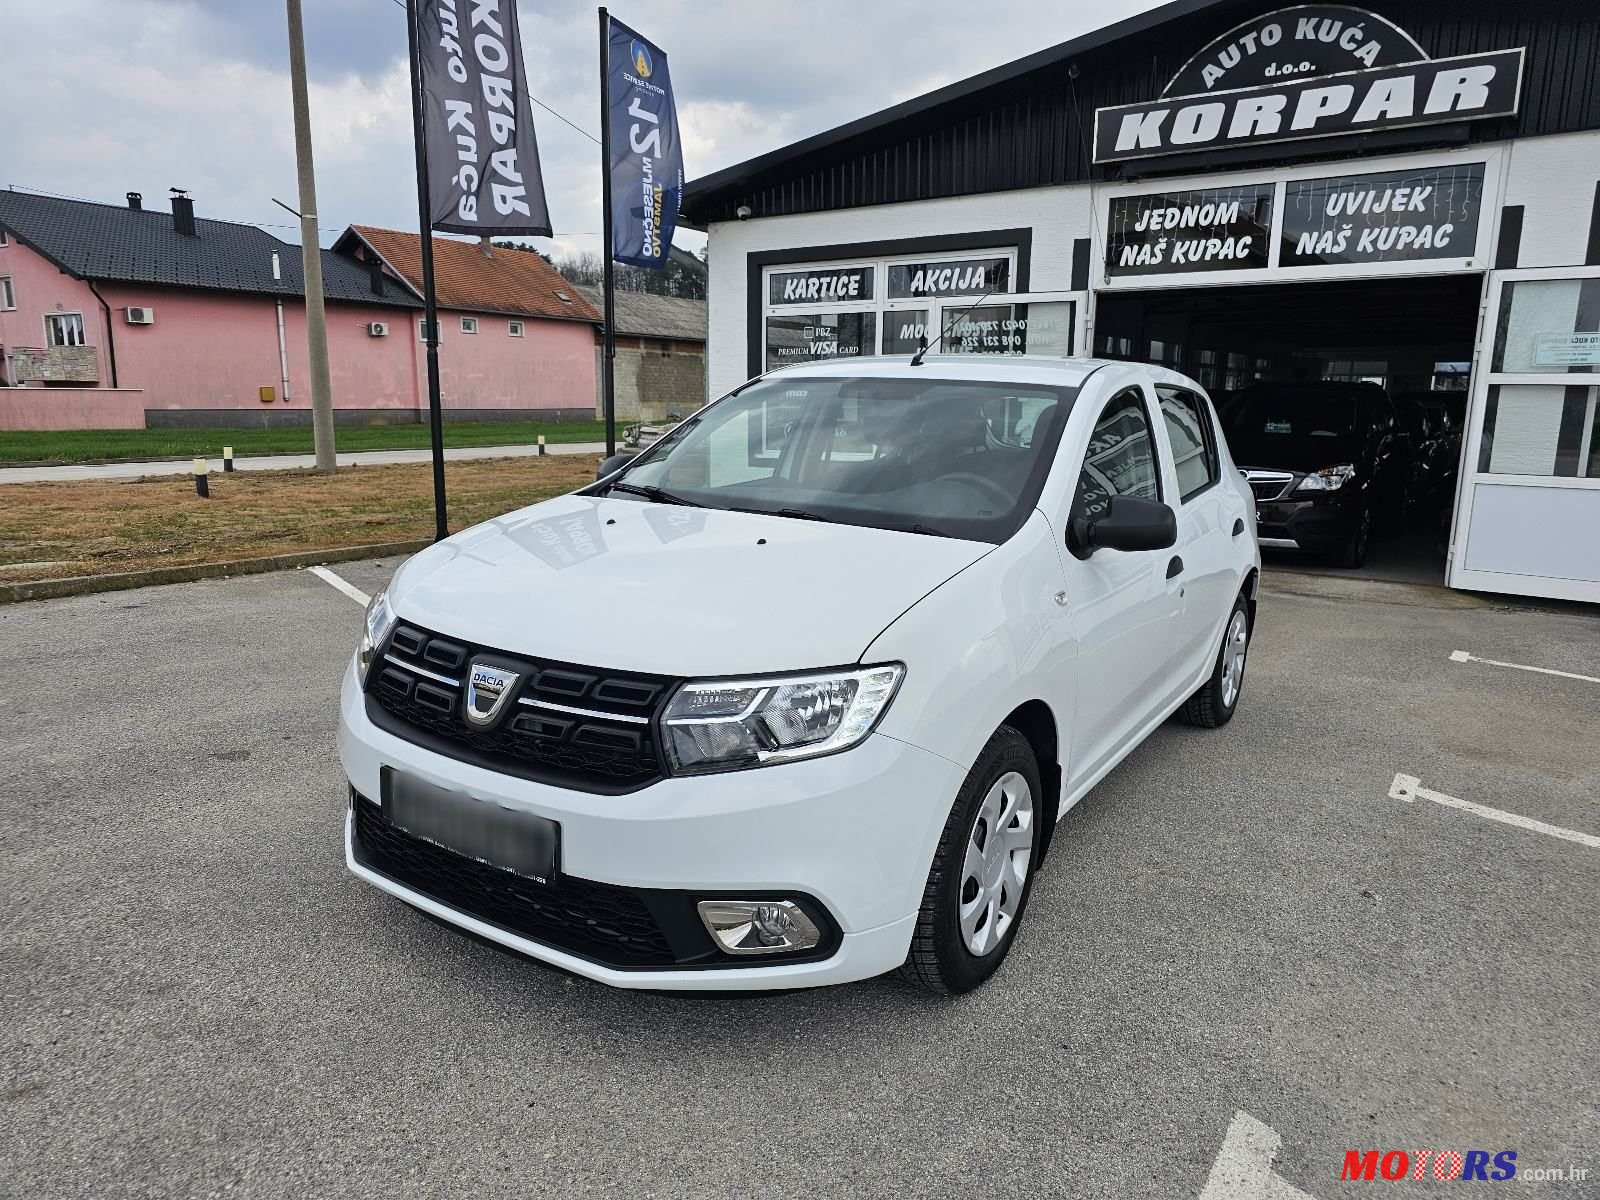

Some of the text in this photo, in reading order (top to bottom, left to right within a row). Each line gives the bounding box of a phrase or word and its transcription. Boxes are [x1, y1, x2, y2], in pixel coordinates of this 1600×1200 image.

[1201, 17, 1382, 89] AUTO KUĆA
[1264, 61, 1317, 77] d.o.o.
[1114, 64, 1496, 153] KORPAR
[1326, 185, 1433, 217] UVIJEK
[1135, 202, 1240, 232] JEDNOM
[1119, 236, 1253, 267] NAŠ KUPAC
[1296, 223, 1454, 256] NAŠ KUPAC
[783, 274, 861, 300] KARTICE
[910, 266, 986, 293] AKCIJA
[815, 327, 831, 337] PBZ
[778, 341, 859, 356] PREMIUM VISA CARD
[473, 673, 504, 688] DACIA
